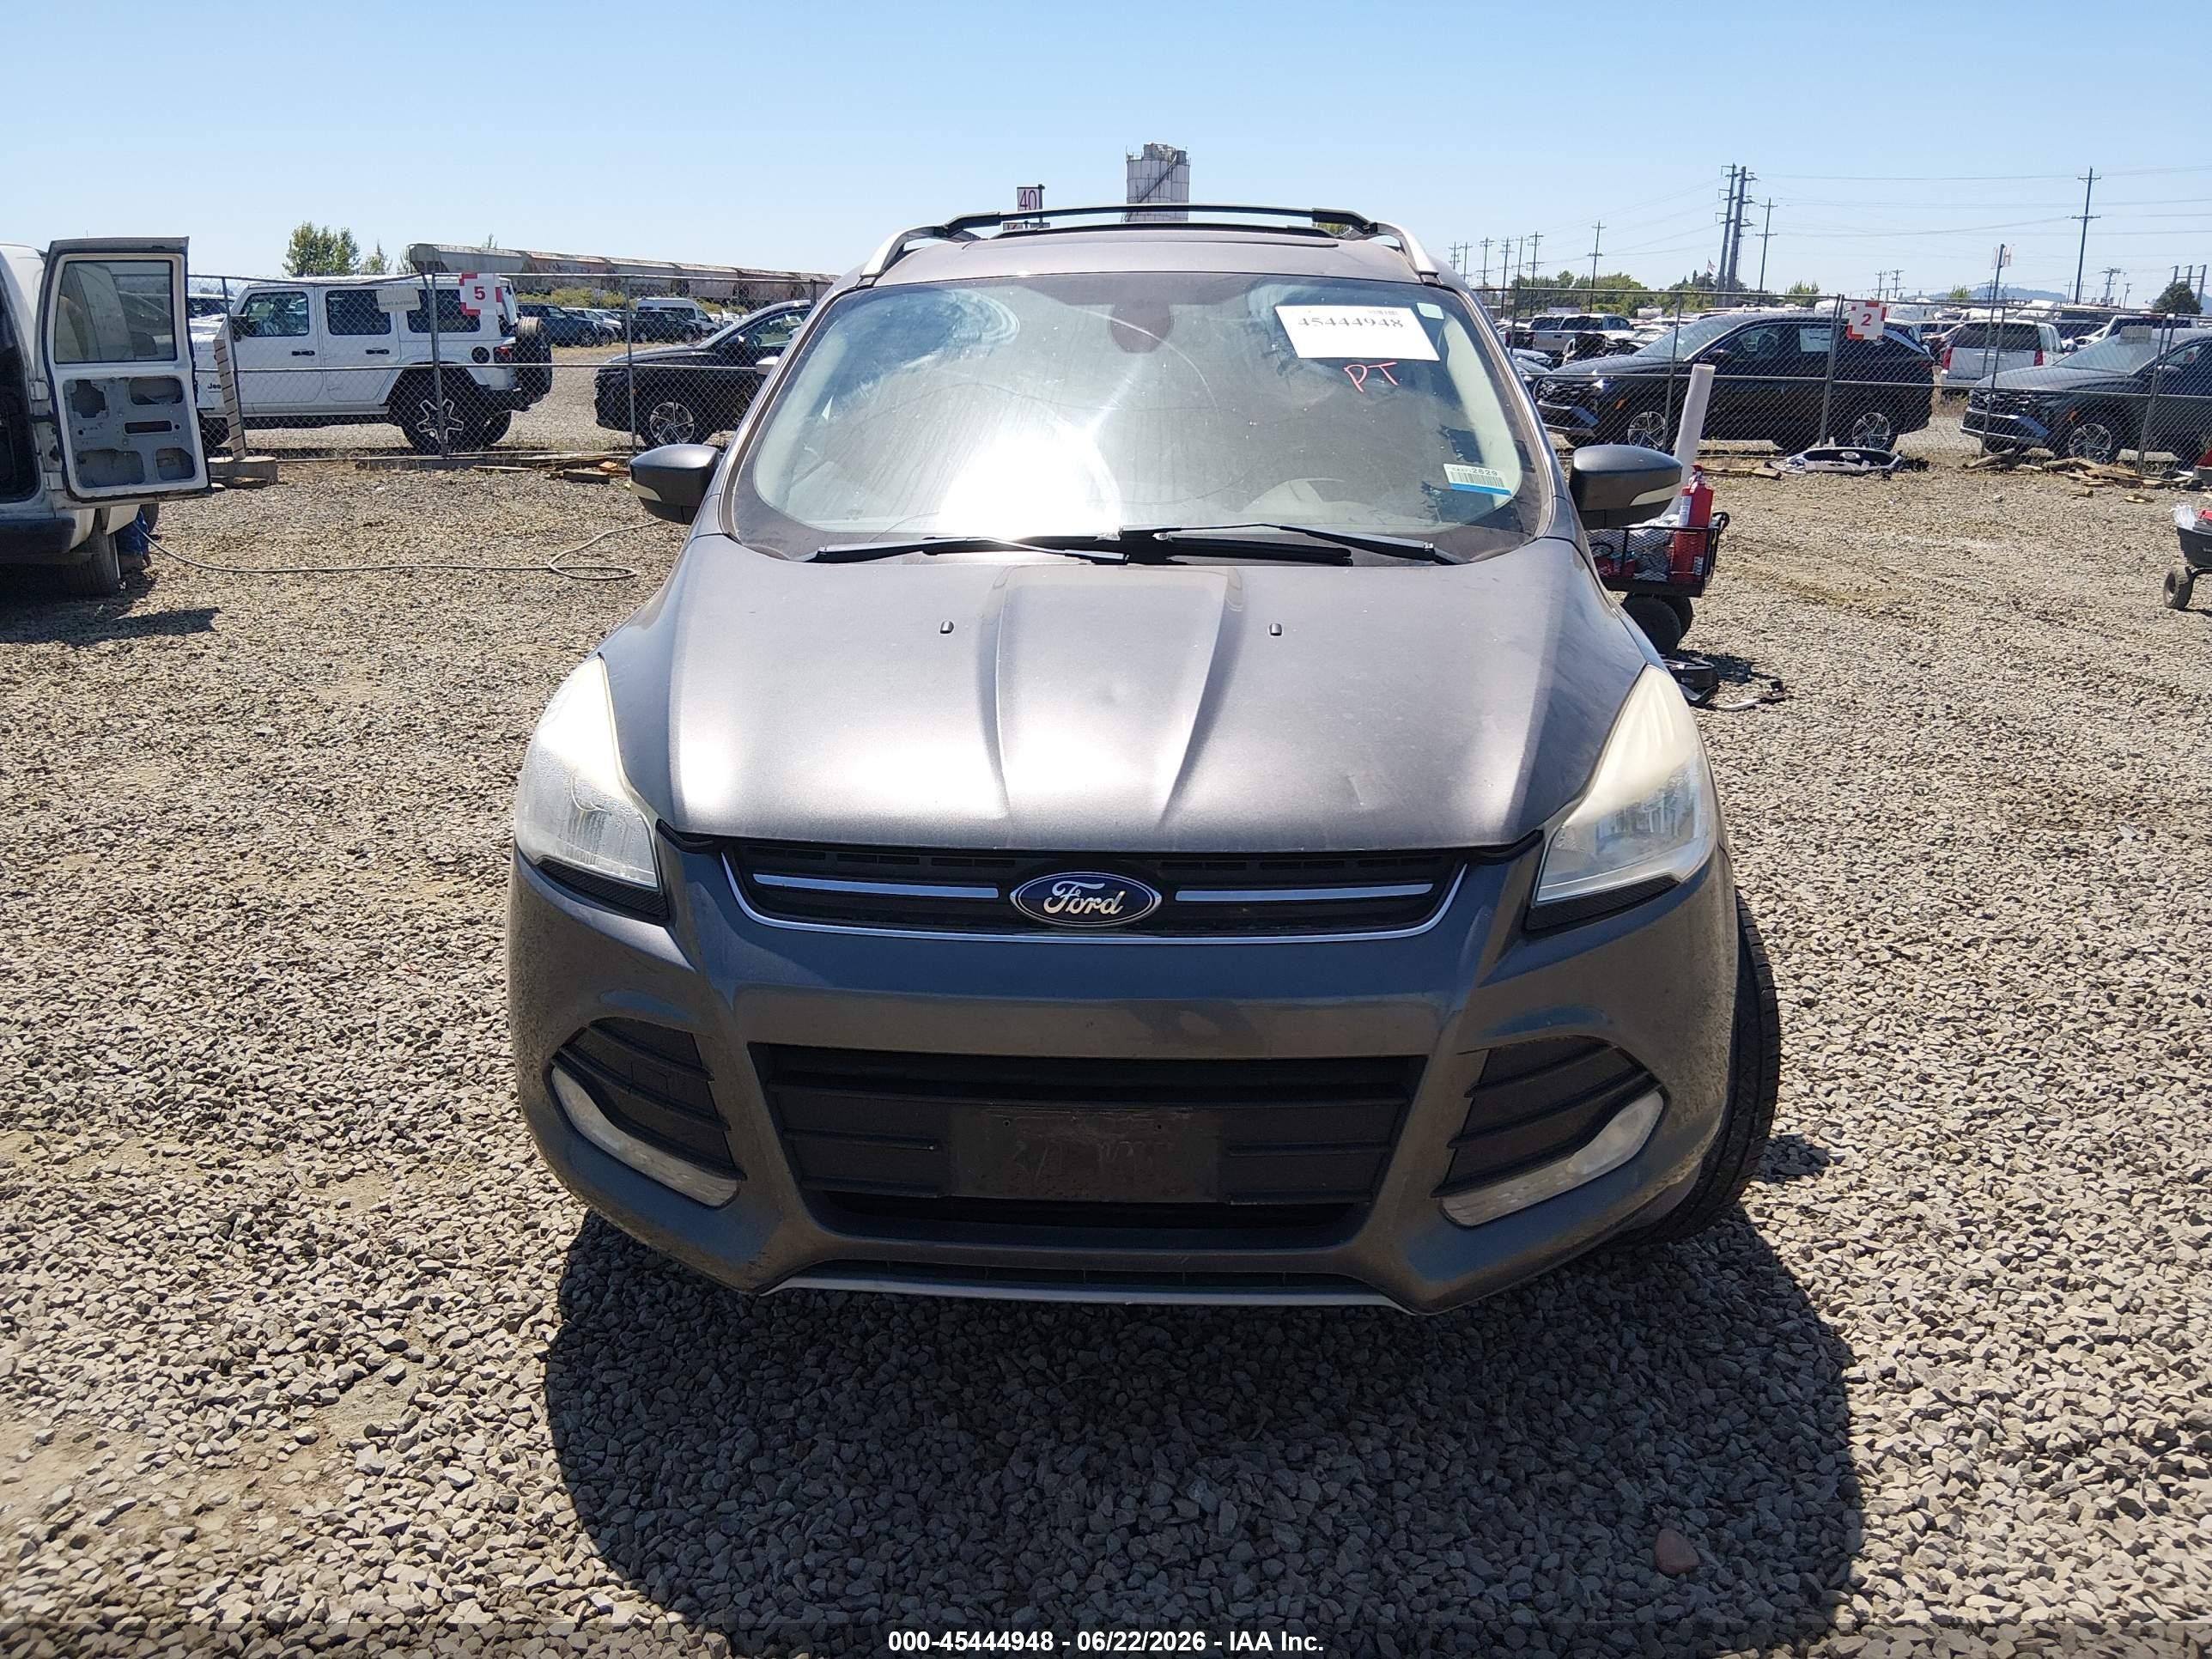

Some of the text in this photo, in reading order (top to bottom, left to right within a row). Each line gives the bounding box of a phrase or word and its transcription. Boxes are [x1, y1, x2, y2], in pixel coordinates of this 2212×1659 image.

[1019, 189, 1037, 211] 40
[474, 286, 486, 301] 5
[1297, 317, 1404, 329] 45444948
[1861, 313, 1872, 326] 2
[1343, 362, 1400, 393] PT
[1043, 880, 1126, 915] Ford
